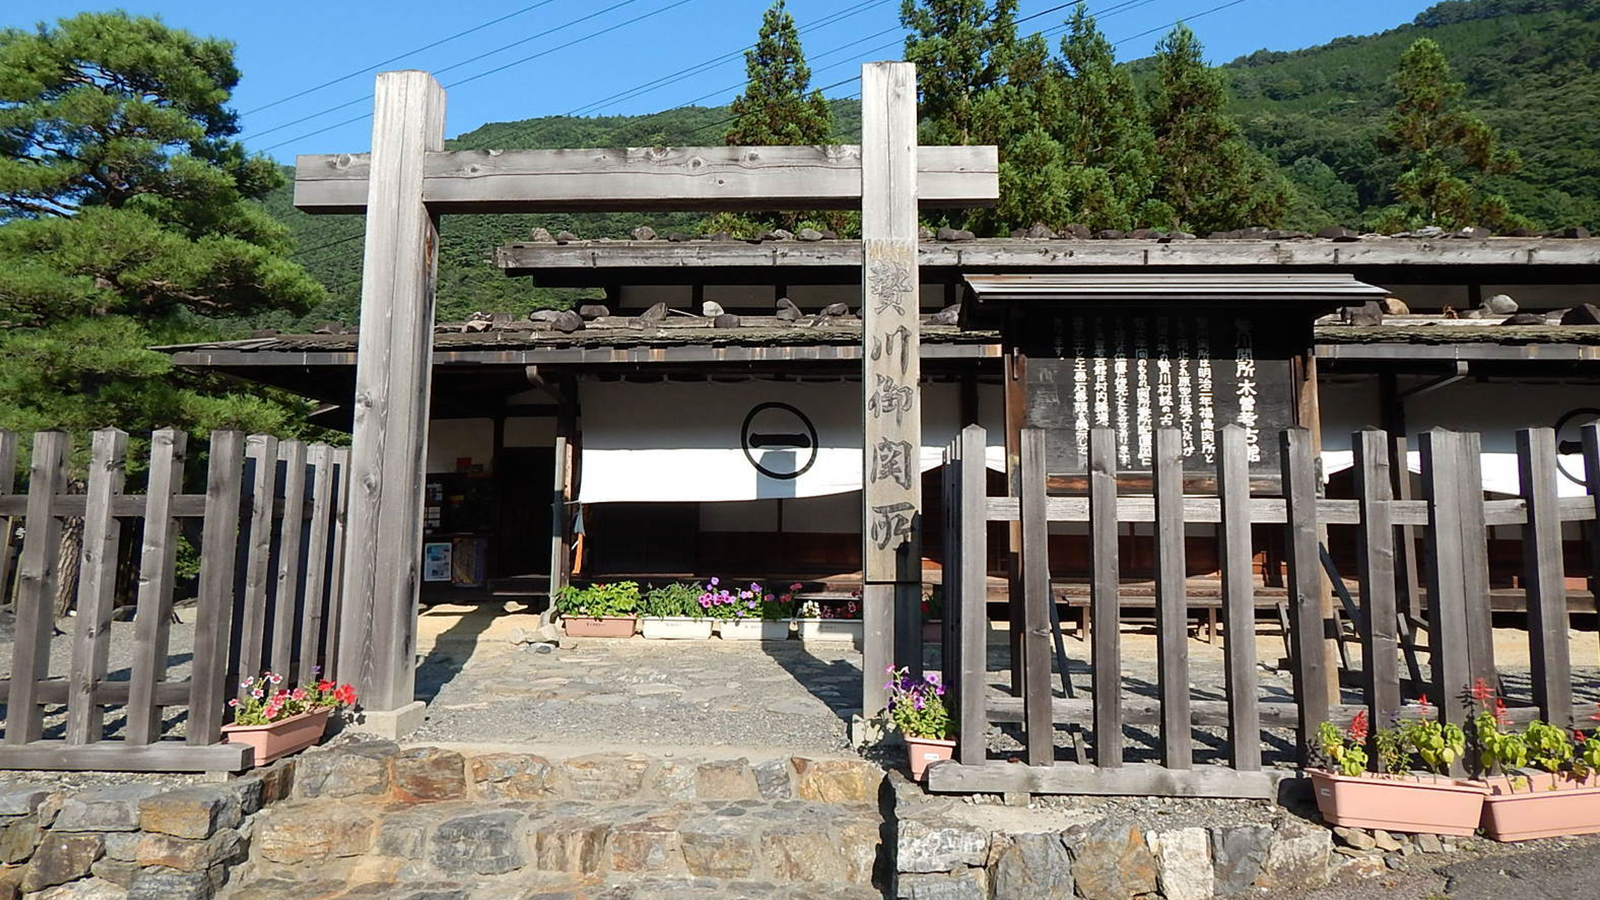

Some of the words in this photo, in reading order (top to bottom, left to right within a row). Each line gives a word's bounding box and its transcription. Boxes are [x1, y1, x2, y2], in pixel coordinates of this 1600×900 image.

[867, 262, 916, 551] 贄川御関所
